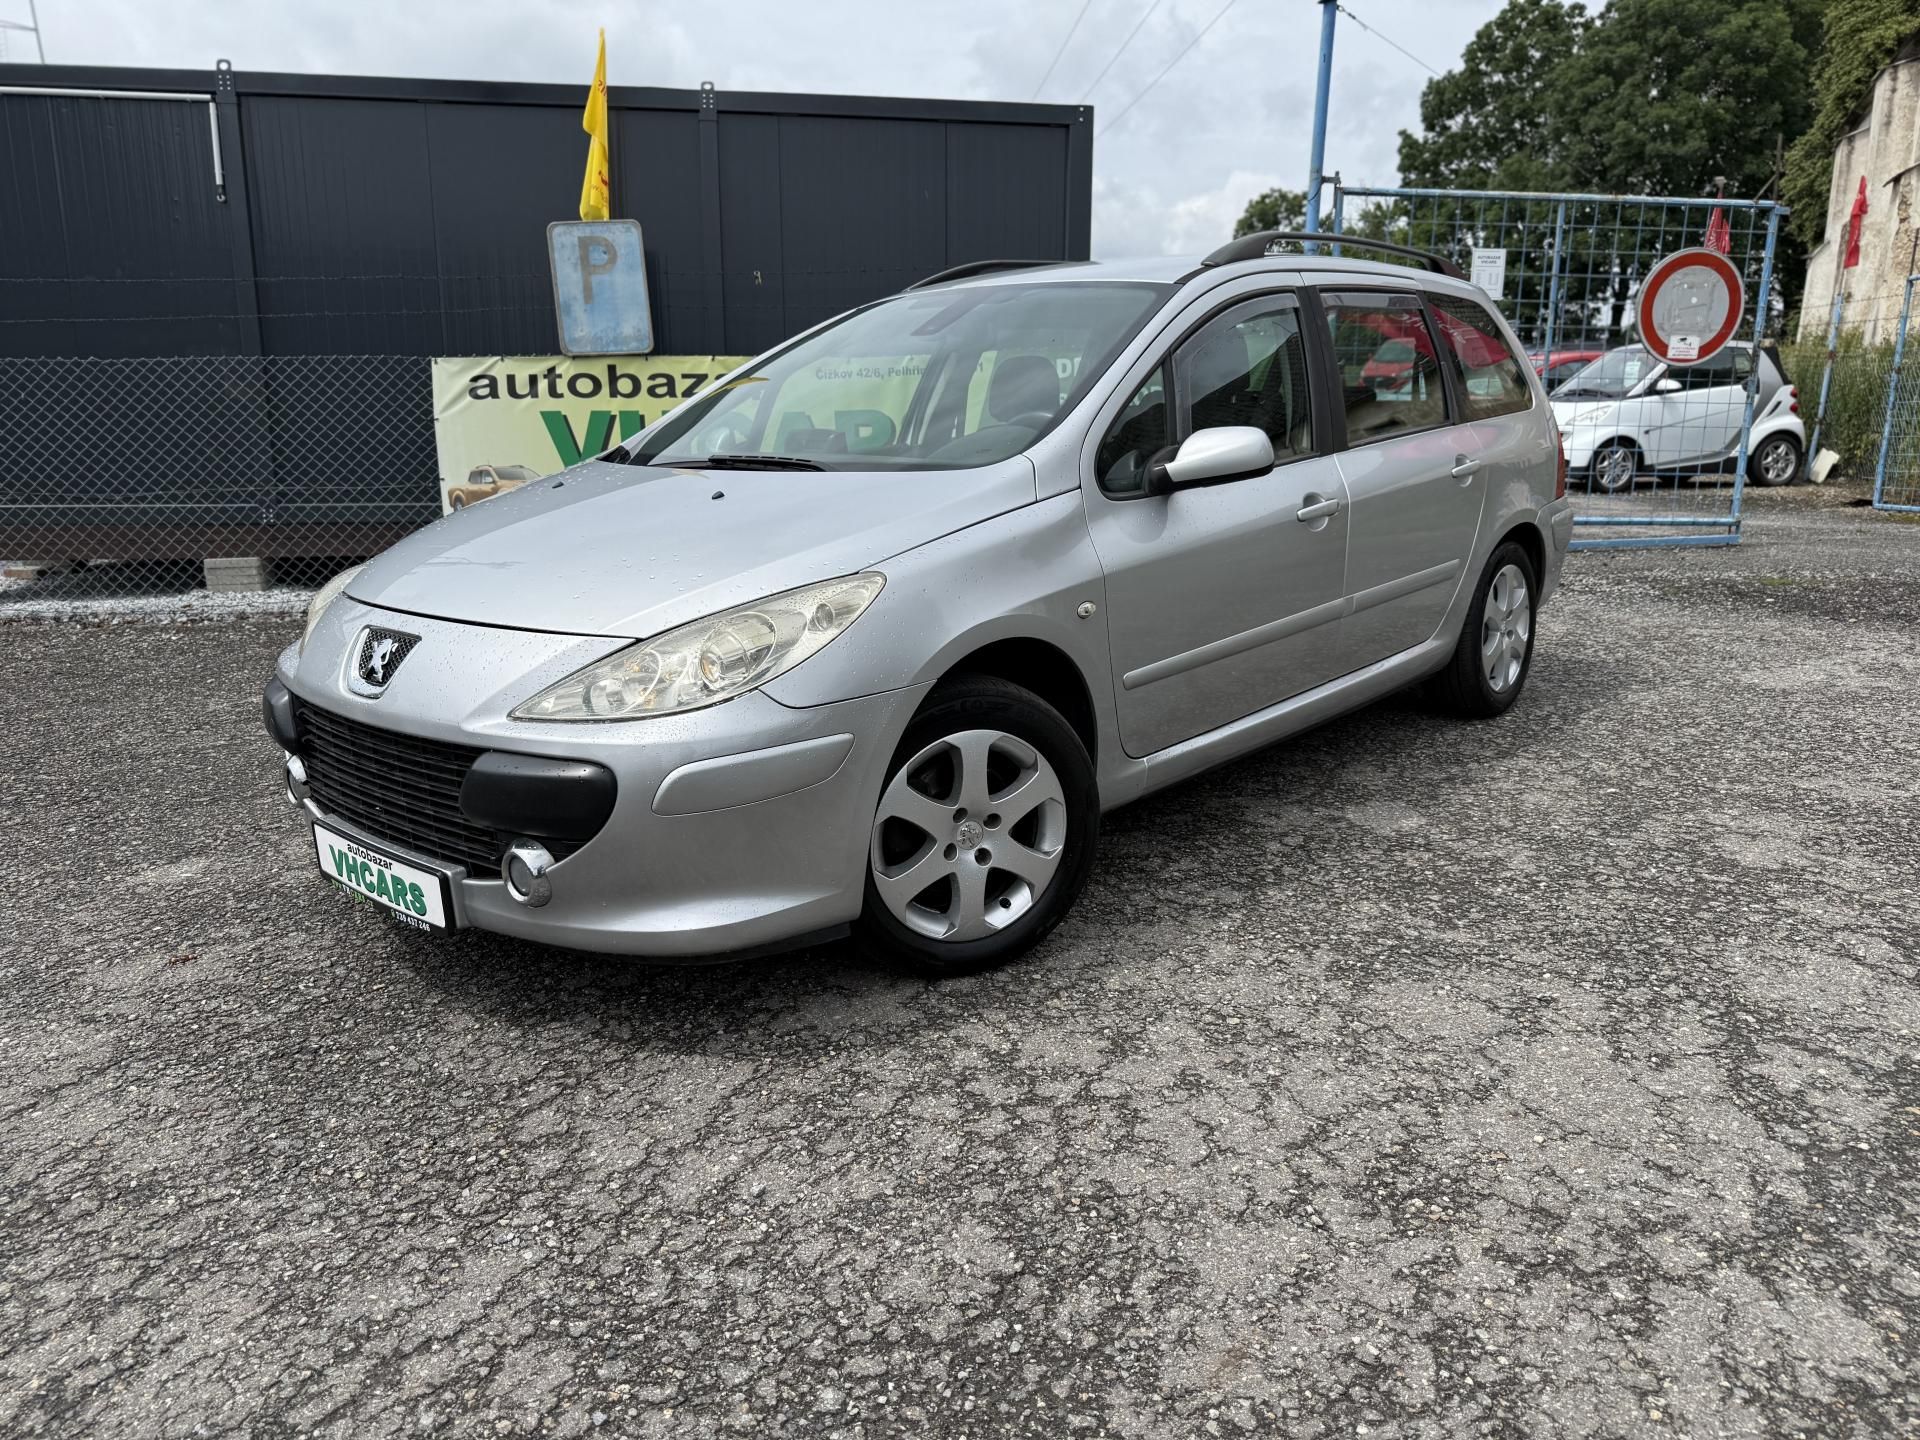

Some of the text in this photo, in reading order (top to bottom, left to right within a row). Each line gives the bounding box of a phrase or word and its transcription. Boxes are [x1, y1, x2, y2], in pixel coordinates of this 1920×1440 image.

[577, 235, 618, 305] P
[468, 364, 731, 400] autobaz
[328, 844, 427, 916] VHCARS
[347, 843, 393, 871] autobazar
